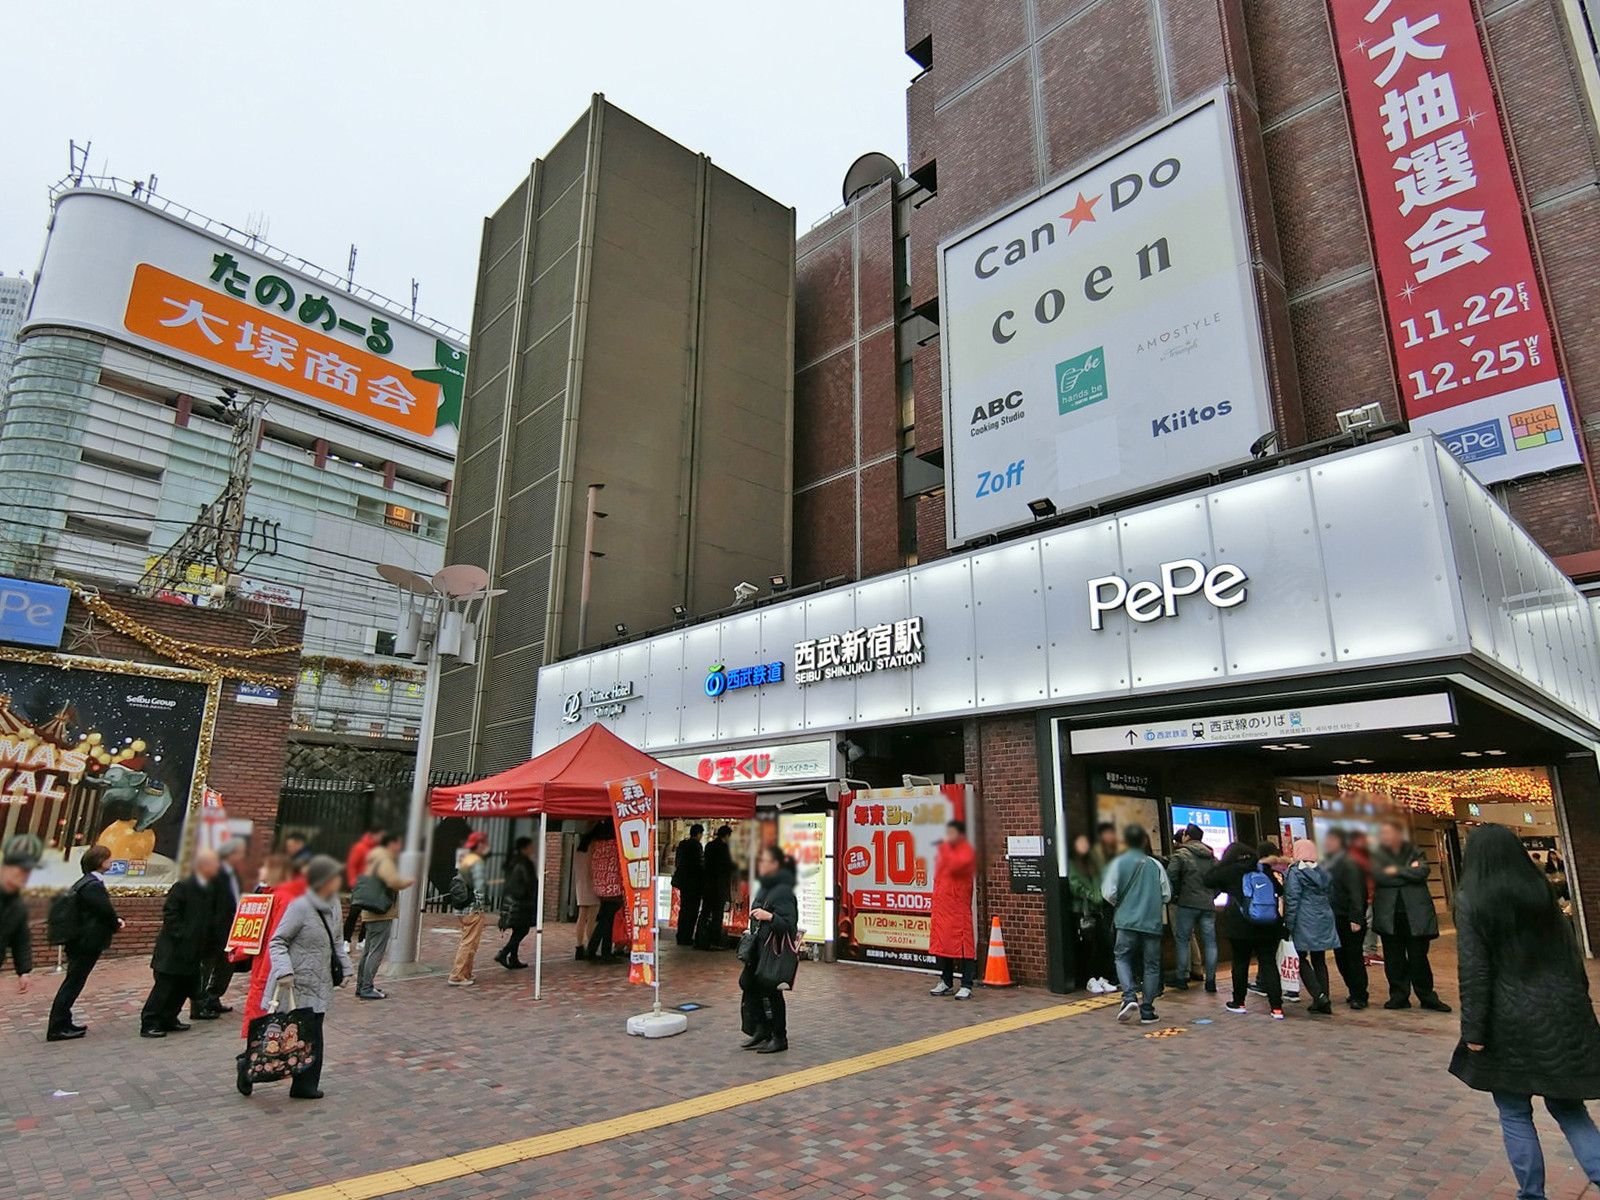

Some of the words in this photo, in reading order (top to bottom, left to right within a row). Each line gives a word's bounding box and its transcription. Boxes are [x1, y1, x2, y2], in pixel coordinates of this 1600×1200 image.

[1363, 0, 1491, 284] 大抽選会
[974, 221, 1056, 280] Can
[209, 252, 395, 355] たのめーる
[991, 236, 1173, 346] coen
[1400, 286, 1518, 349] 11.22
[1515, 281, 1531, 312] FRI
[158, 295, 418, 416] 大塚商会
[1408, 339, 1527, 401] 12.25
[1523, 334, 1541, 368] WED
[970, 390, 1024, 425] ABC
[1062, 389, 1089, 405] hands
[1091, 384, 1103, 393] be
[970, 420, 999, 438] Cooking
[1001, 410, 1025, 426] Studio
[1150, 399, 1233, 438] Kiitos
[1515, 409, 1553, 427] Brick
[1535, 421, 1555, 433] St.
[1446, 432, 1496, 456] ePe
[975, 459, 1025, 499] Zoff
[1087, 557, 1249, 632] PePe
[793, 616, 924, 673] 西武新宿駅
[727, 661, 785, 691] 西武鉄道
[794, 669, 822, 685] SEIBU
[825, 660, 874, 679] SHINJUKU
[877, 652, 923, 671] STATION
[126, 694, 150, 705] Seibu
[151, 696, 177, 708] Group
[589, 689, 612, 703] Prince
[612, 681, 633, 698] Hotel
[594, 704, 626, 719] Shinjuku
[1209, 713, 1286, 733] 西武線のりば
[1157, 729, 1188, 740] 西武鉄道
[1210, 733, 1228, 742] Seibu
[1229, 732, 1240, 740] Line
[1241, 730, 1268, 739] Entrance
[715, 753, 771, 782] 宝くじ
[453, 791, 509, 811] 大黒天宝くじ
[1188, 810, 1211, 825] ご案内
[870, 830, 916, 885] 10
[862, 892, 882, 906] ミニ
[886, 892, 932, 909] 5,000万
[232, 917, 264, 940] 寅の日
